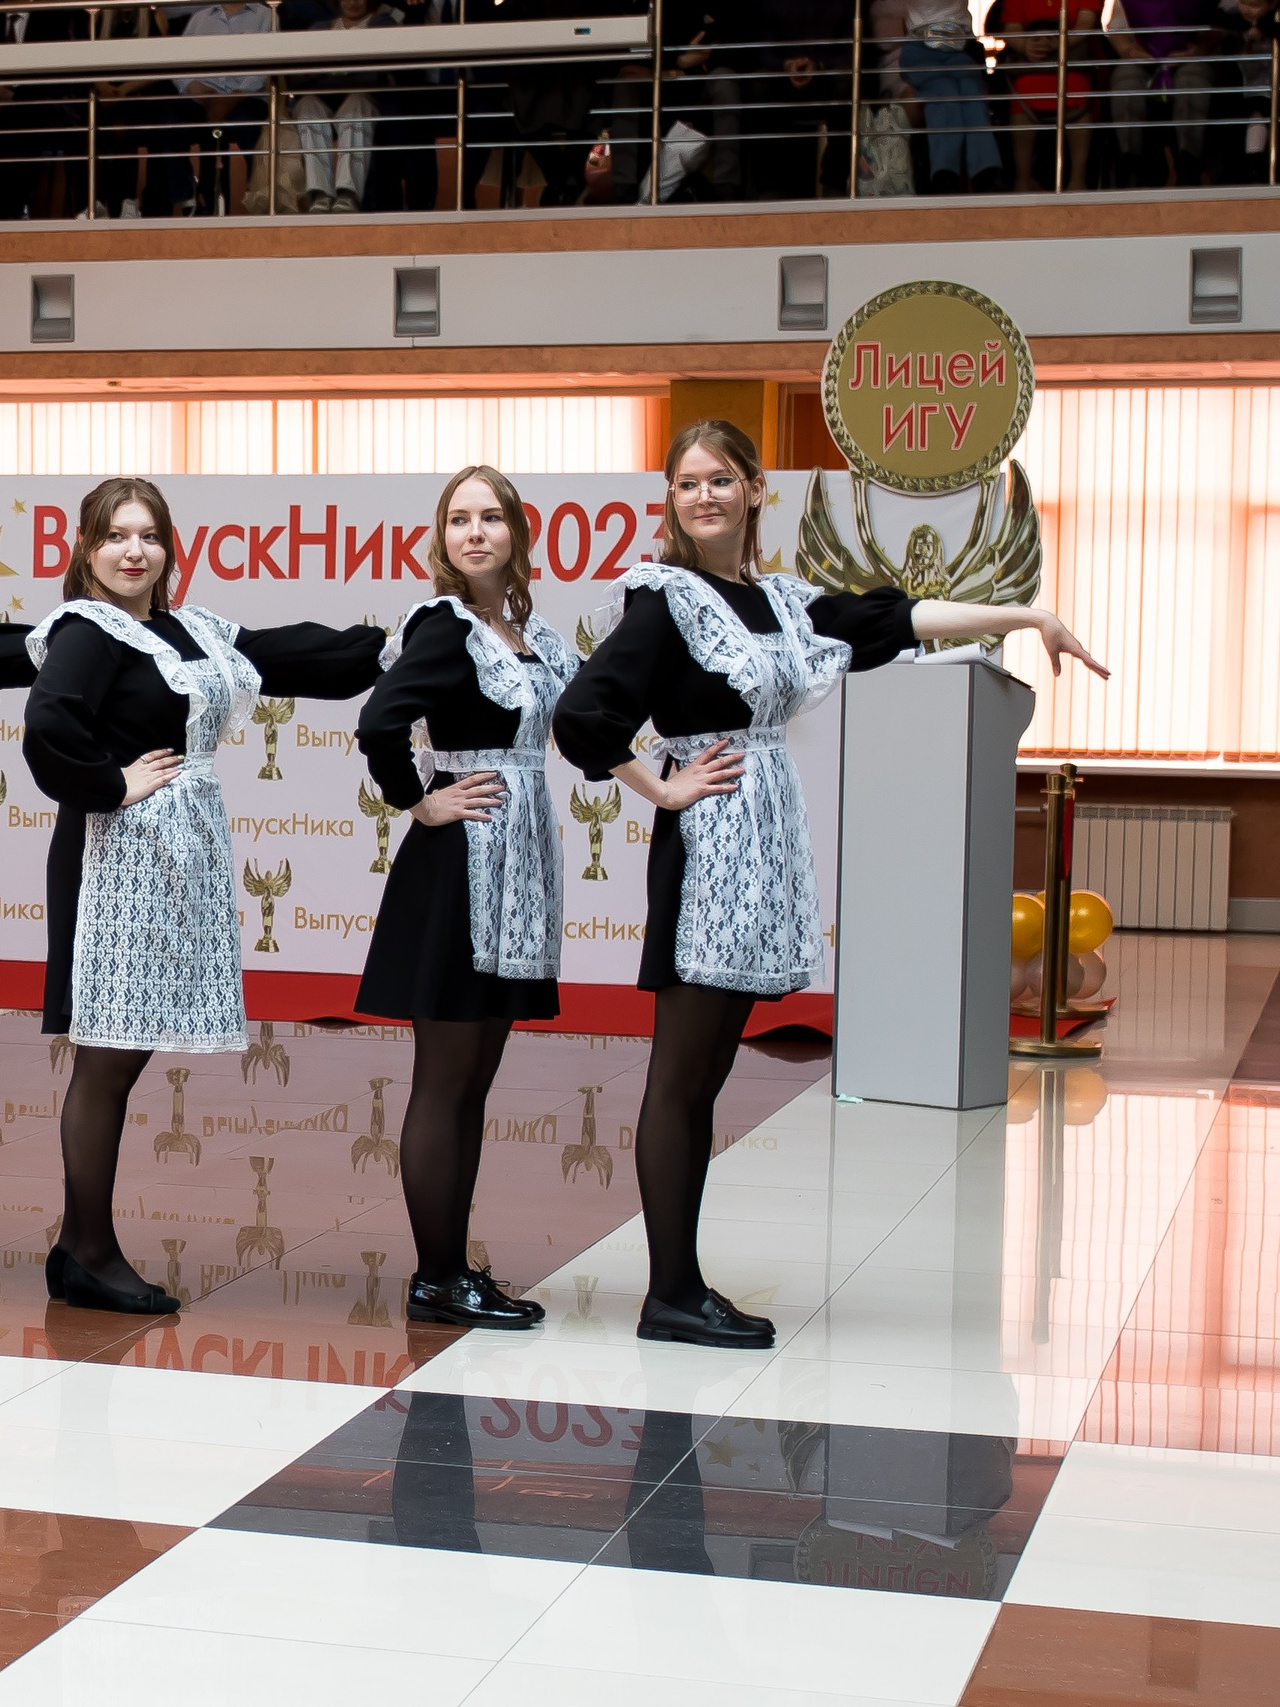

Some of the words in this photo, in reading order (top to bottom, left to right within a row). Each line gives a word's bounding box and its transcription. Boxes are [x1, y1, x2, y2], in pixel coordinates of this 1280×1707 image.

[848, 340, 1007, 395] Лицей
[883, 402, 977, 454] ИГУ
[33, 505, 431, 610] ВускНик
[229, 813, 354, 842] пускНика
